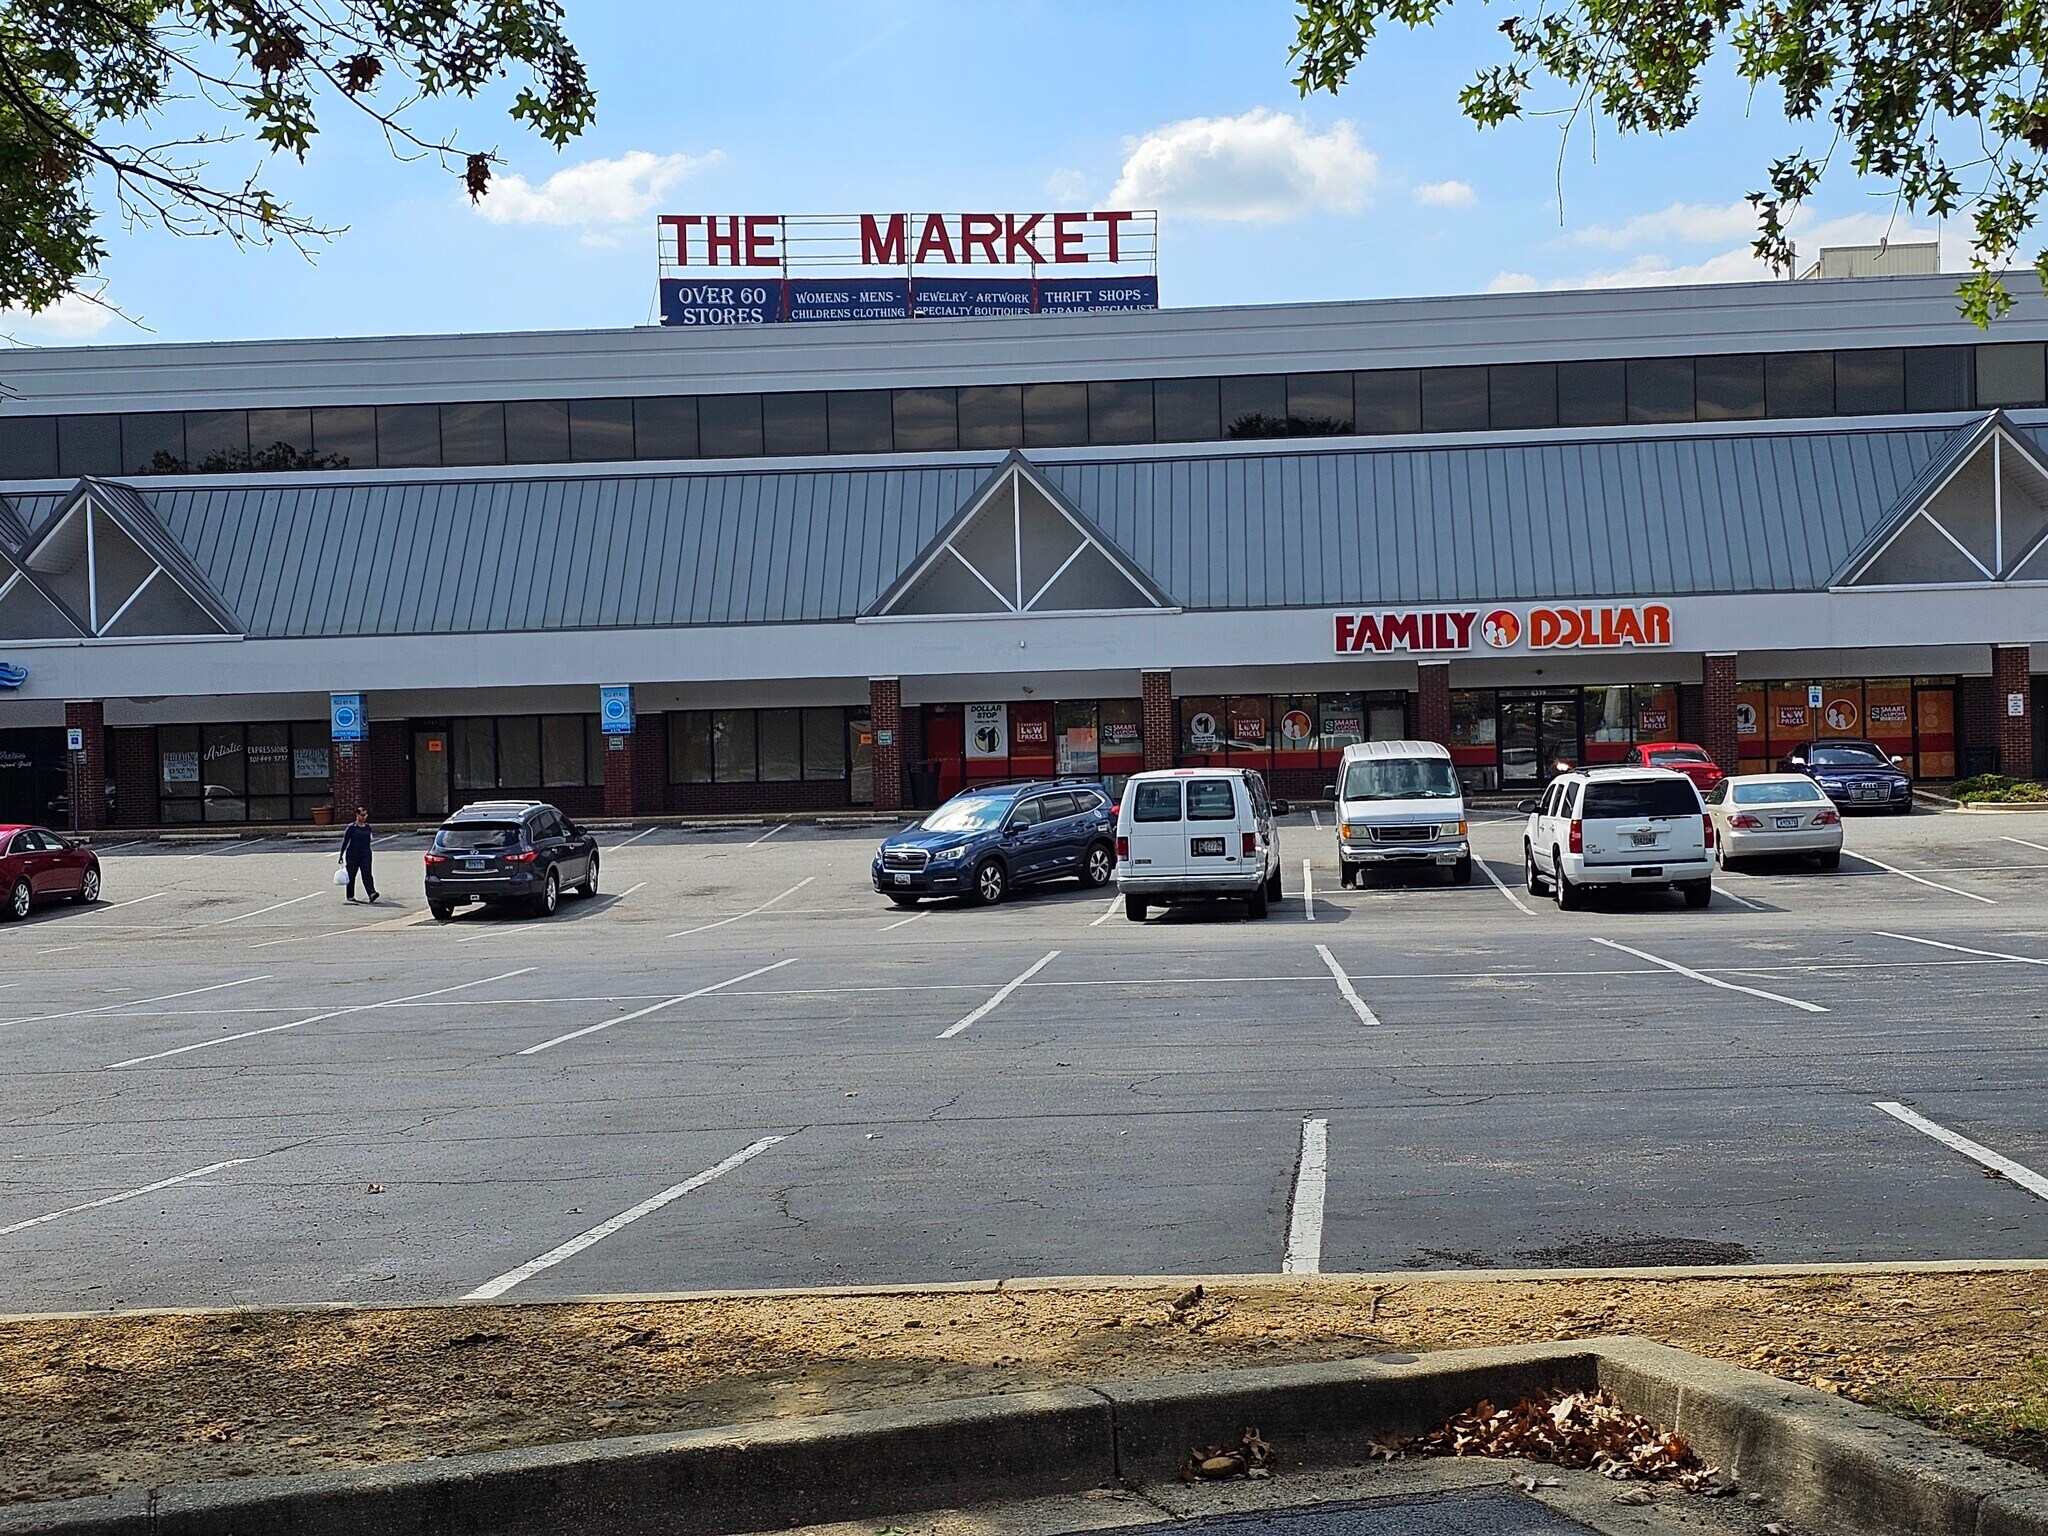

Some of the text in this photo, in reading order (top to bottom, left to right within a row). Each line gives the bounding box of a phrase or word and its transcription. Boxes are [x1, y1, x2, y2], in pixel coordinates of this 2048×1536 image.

[661, 212, 1132, 266] THE MARKET
[678, 286, 767, 306] OVER 60
[795, 291, 849, 304] WOMENS
[859, 291, 894, 304] MENS
[916, 291, 968, 304] JEWELRY
[976, 292, 1030, 304] ARTWORK
[1045, 291, 1092, 303] THRIFT
[1099, 289, 1141, 302] SHOPS
[683, 307, 764, 325] STORES
[791, 307, 906, 320] CHILDRENS CLOTHING
[974, 307, 1031, 316] BOUTIQUES
[1335, 605, 1671, 652] FAMILY DOLLAR
[970, 704, 1002, 712] DOLLAR
[1880, 705, 1906, 713] SMART
[203, 742, 244, 761] Artistic
[247, 745, 289, 754] EXPRESSIONS
